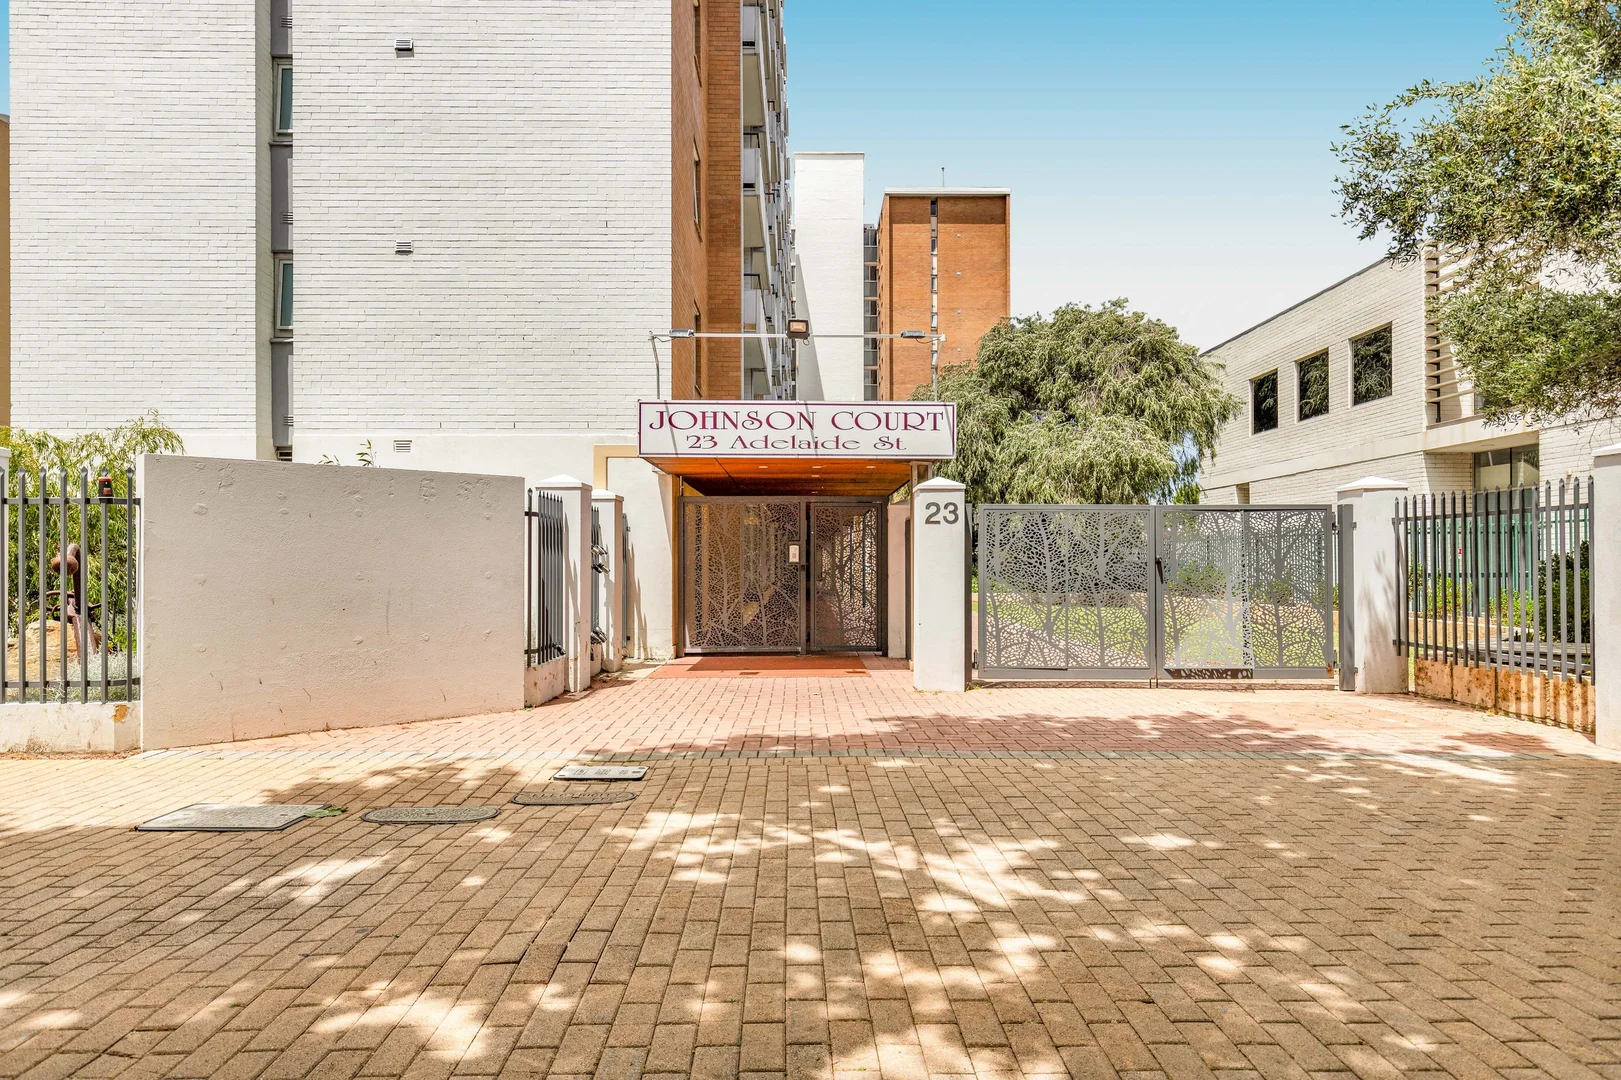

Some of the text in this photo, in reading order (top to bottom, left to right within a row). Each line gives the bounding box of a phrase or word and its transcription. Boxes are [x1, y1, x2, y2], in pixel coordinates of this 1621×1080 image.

[649, 410, 944, 431] JOHNSON COURT
[686, 434, 907, 450] 23 Adelaide St
[925, 501, 959, 525] 23
